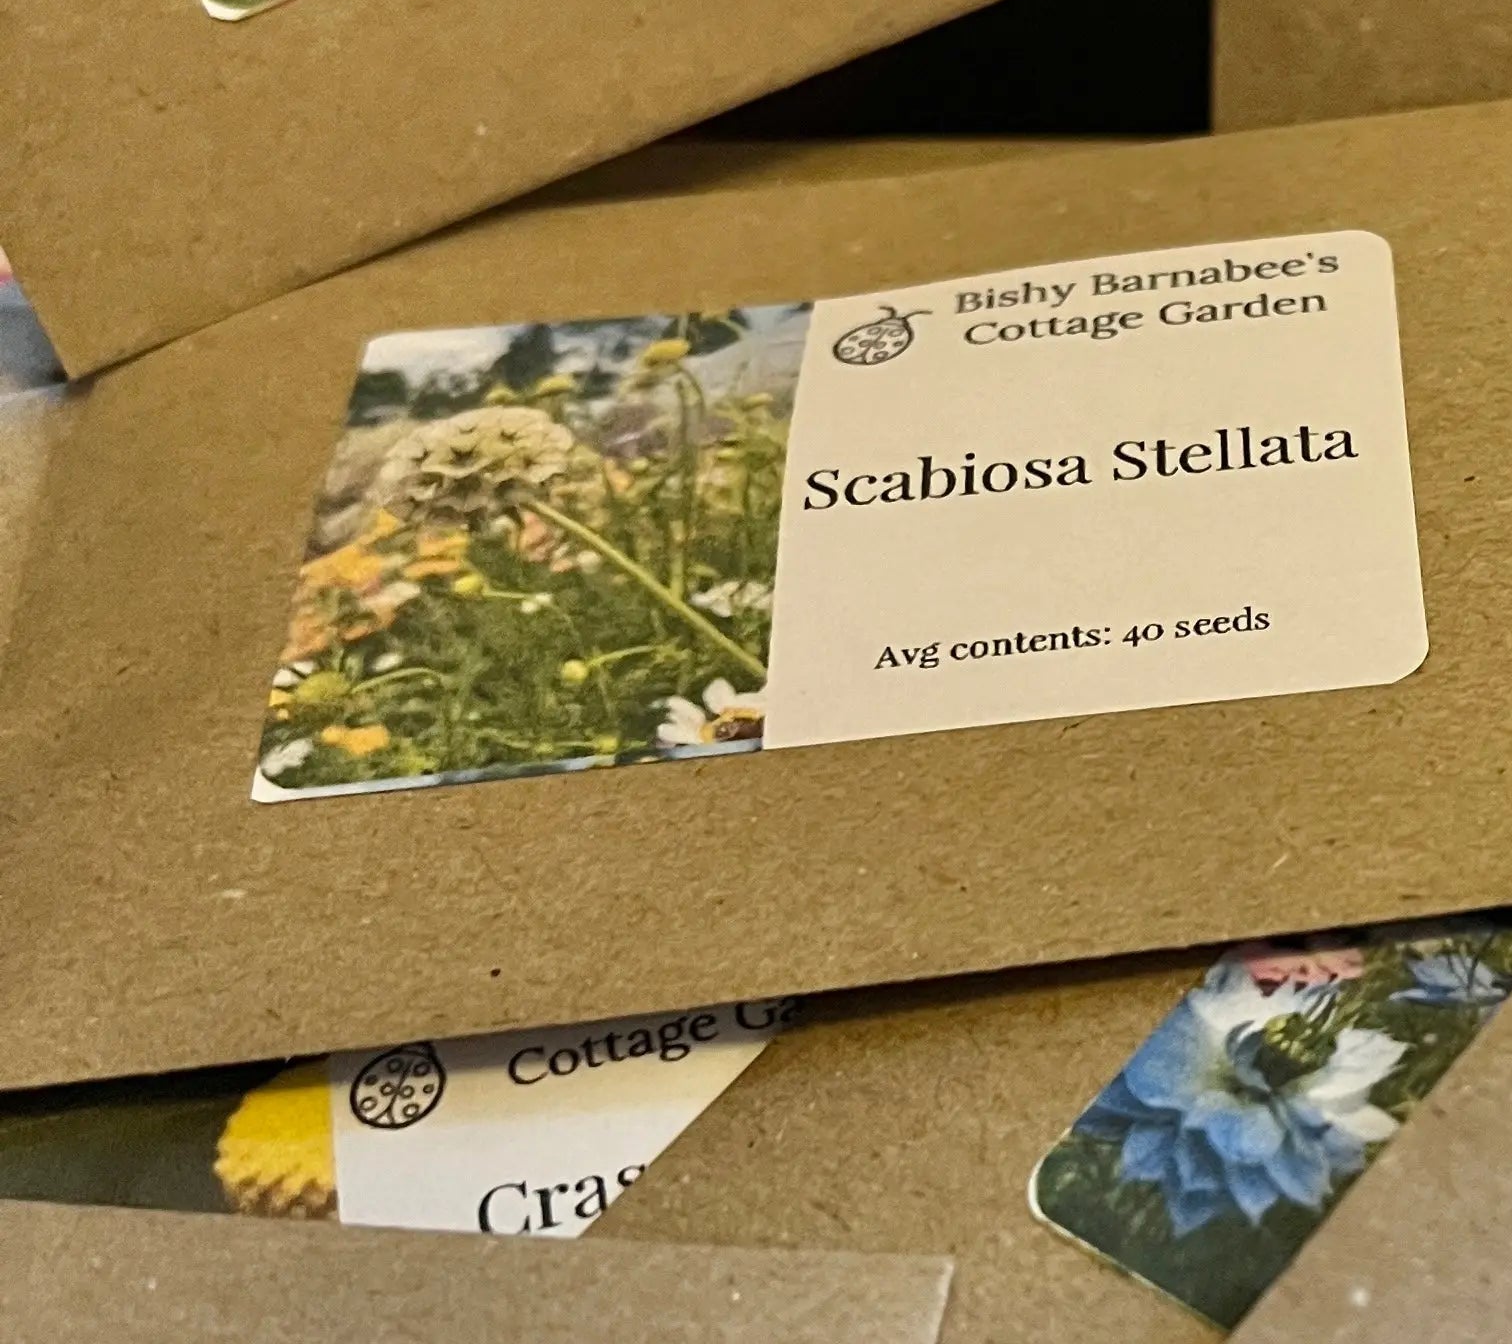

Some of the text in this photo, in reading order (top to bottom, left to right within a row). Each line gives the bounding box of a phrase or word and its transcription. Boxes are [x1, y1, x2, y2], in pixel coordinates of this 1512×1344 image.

[955, 251, 1339, 315] Bishy Barnabee's
[964, 290, 1327, 345] Cottage Garden
[803, 425, 1359, 511] Scabiosa Stellata
[874, 606, 1271, 670] Avg contents: 40 seeds
[508, 1011, 720, 1085] Cottage
